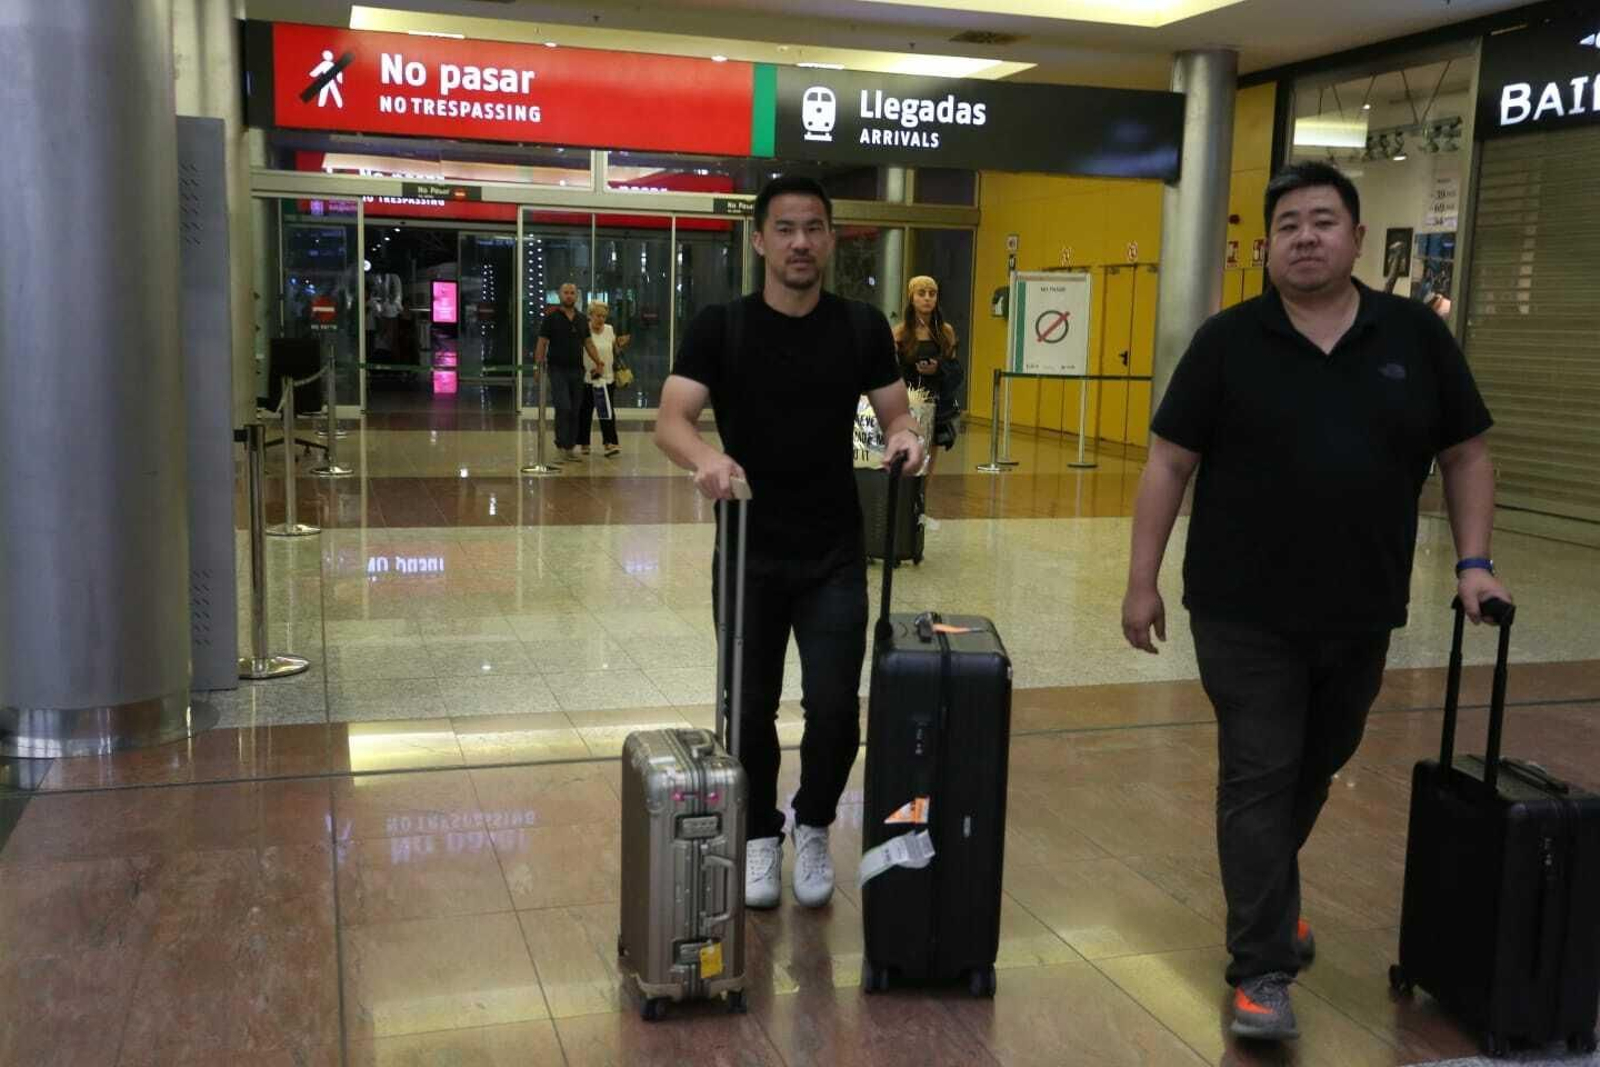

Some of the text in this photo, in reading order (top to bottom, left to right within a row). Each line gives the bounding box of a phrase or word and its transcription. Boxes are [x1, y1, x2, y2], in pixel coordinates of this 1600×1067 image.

[381, 52, 535, 96] No pasar
[379, 95, 541, 123] NO TRESPASSING
[860, 89, 987, 128] Llegadas
[859, 128, 940, 148] ARRIVALS
